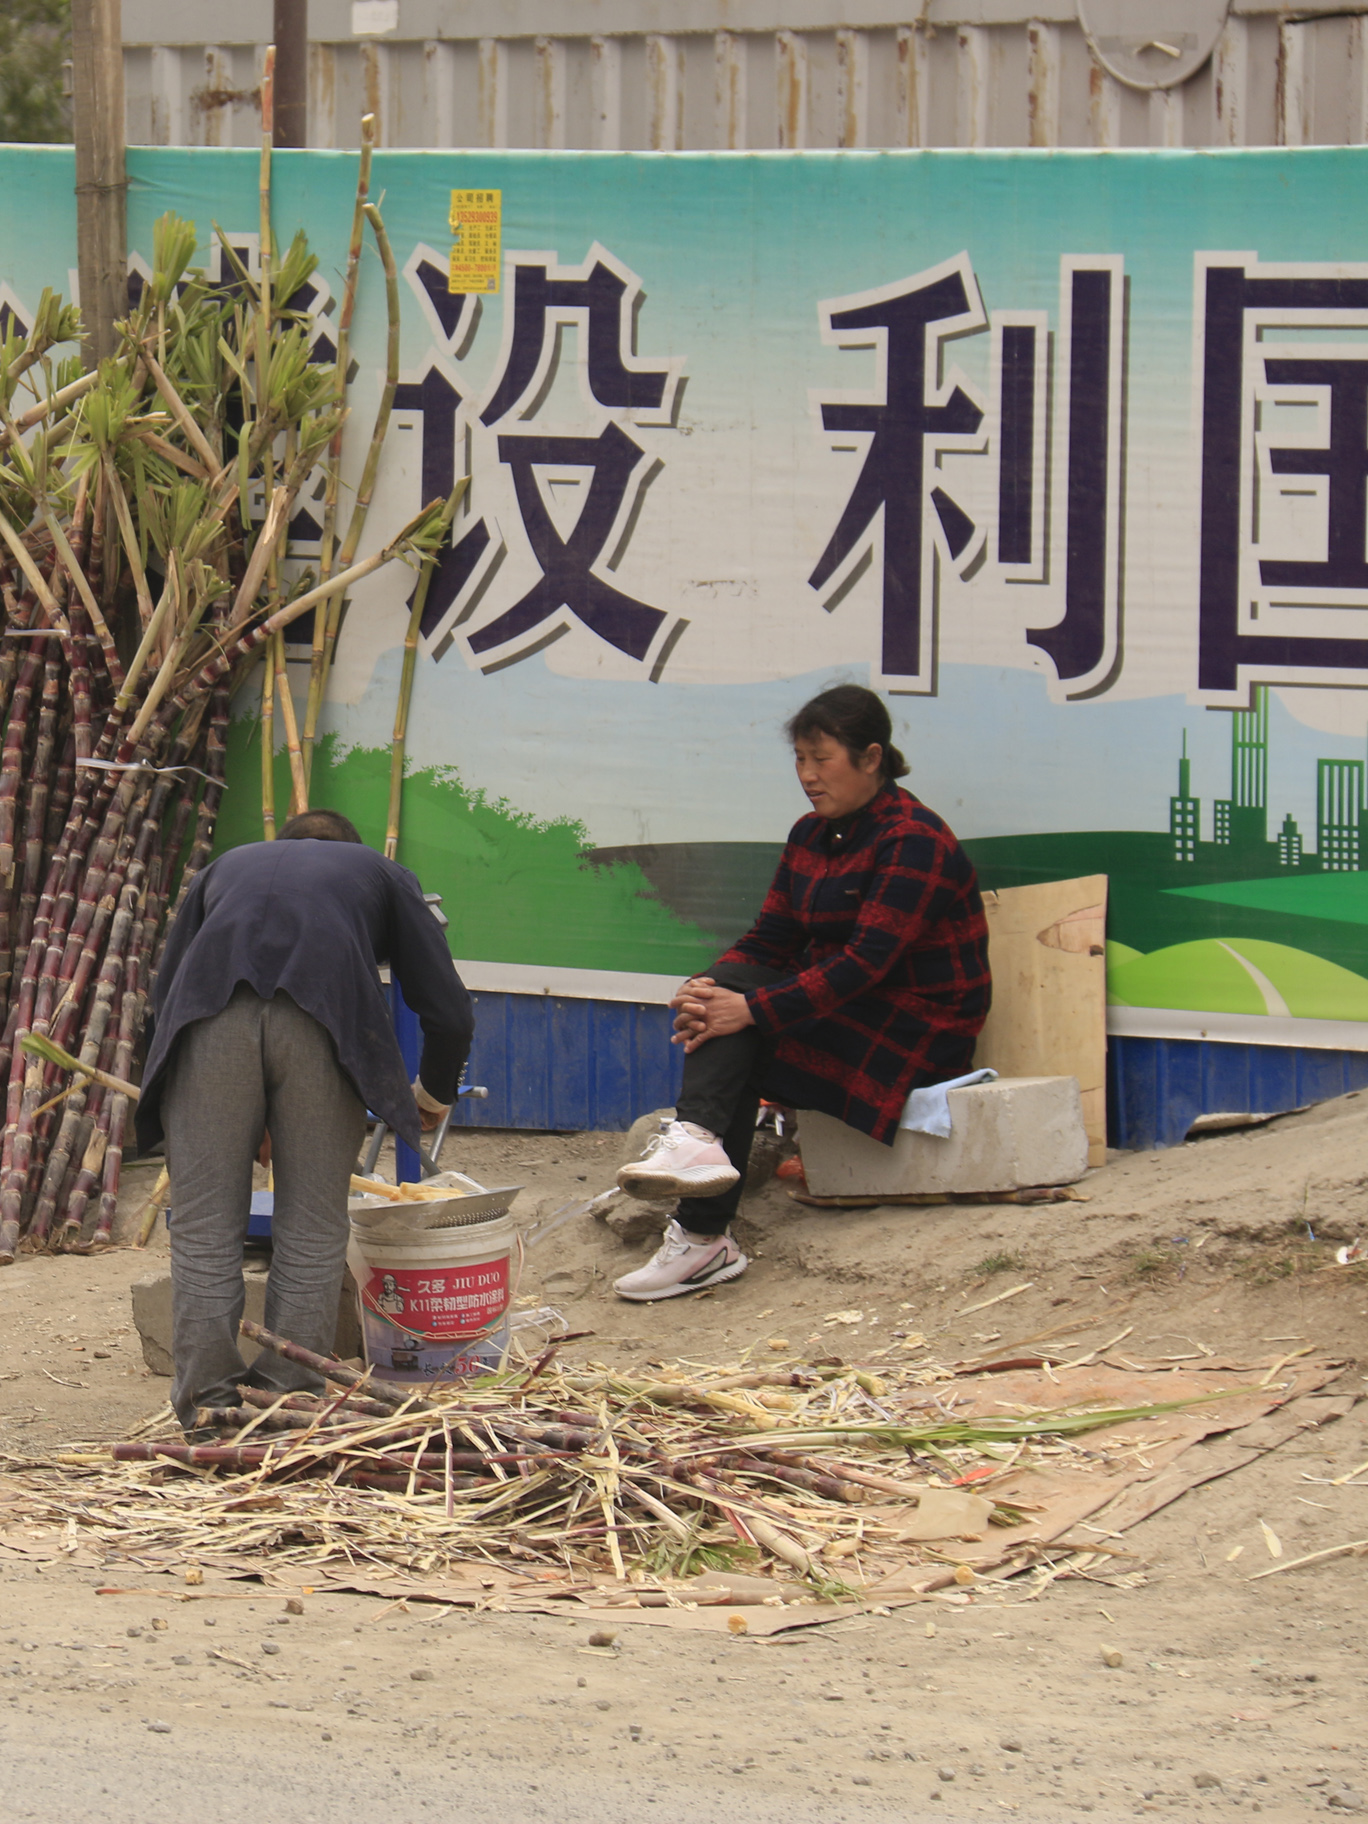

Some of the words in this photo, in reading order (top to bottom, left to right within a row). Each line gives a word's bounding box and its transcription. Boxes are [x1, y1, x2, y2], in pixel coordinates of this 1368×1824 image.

[417, 1279, 446, 1294] 久多
[452, 1276, 475, 1290] JIU
[477, 1271, 501, 1287] DUO
[410, 1287, 505, 1313] K11柔韧型防水涂料
